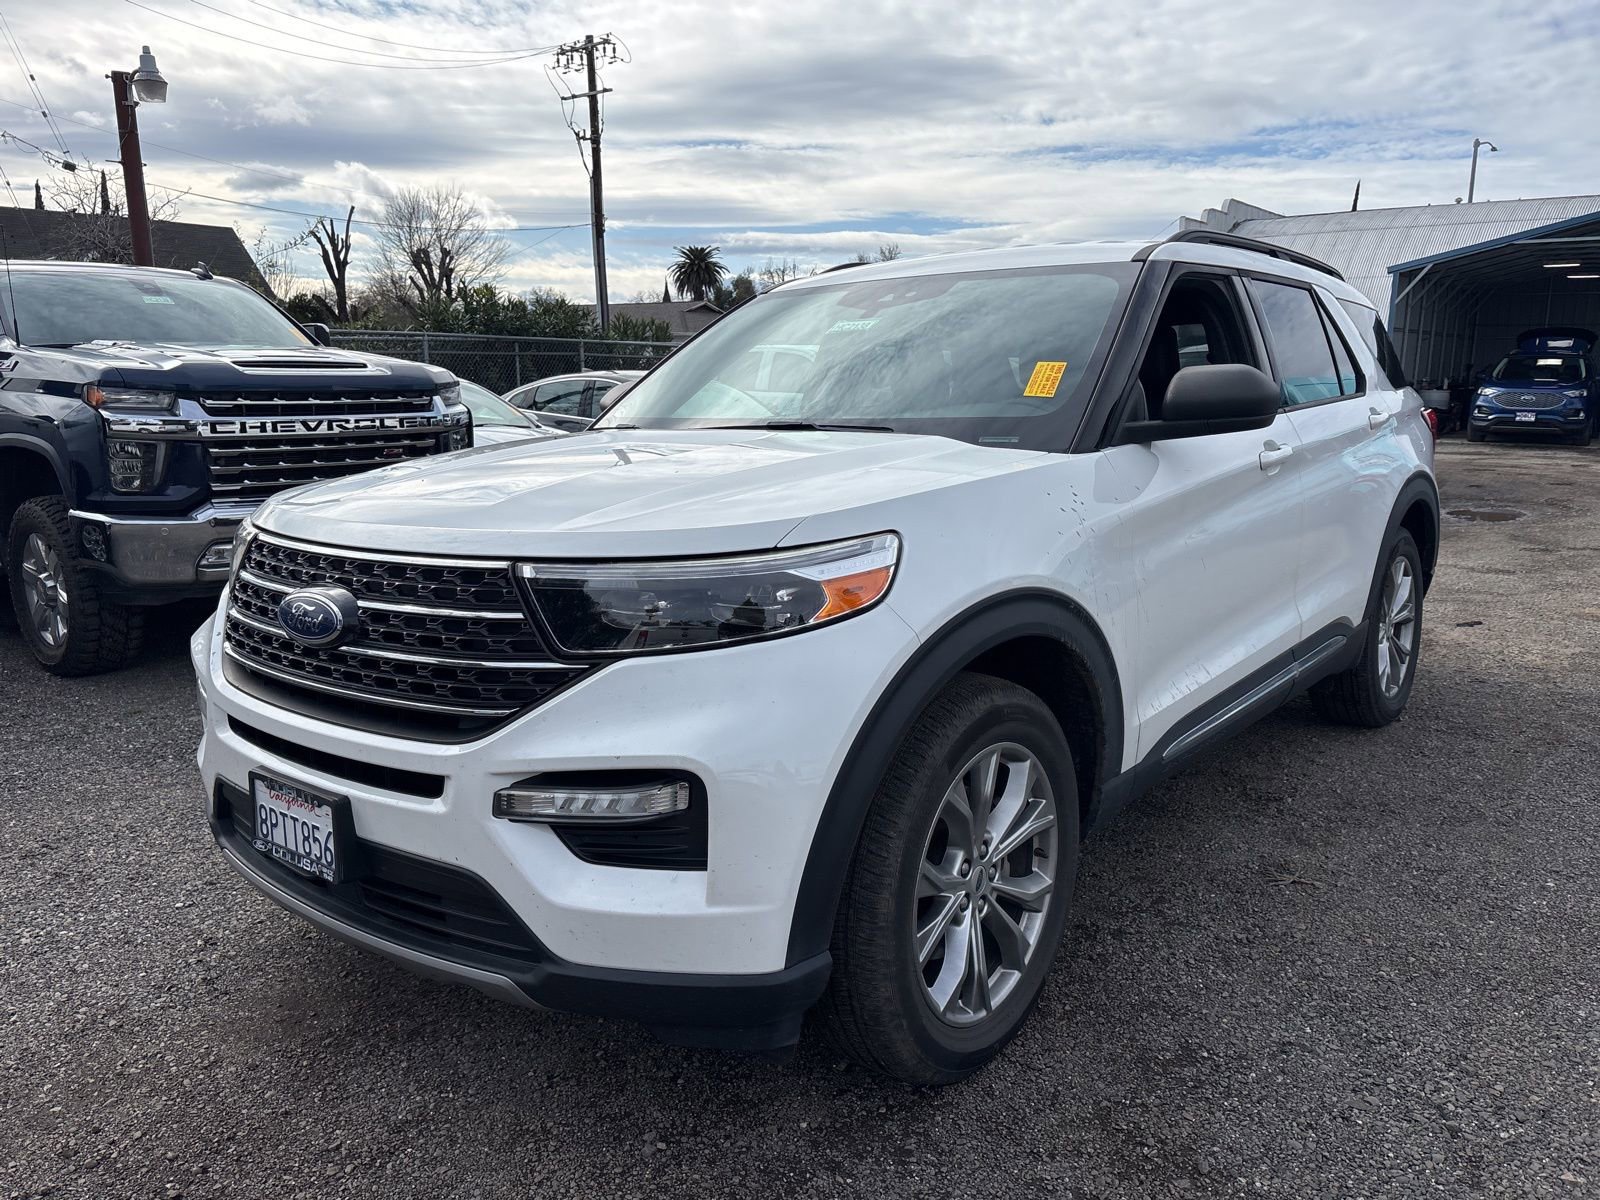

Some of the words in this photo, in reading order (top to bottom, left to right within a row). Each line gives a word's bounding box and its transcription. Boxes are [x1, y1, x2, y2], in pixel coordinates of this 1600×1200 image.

[209, 415, 438, 434] CHEVROLET
[288, 602, 324, 633] Ford
[258, 803, 334, 867] 8PTT856
[272, 845, 320, 876] COLUSA
